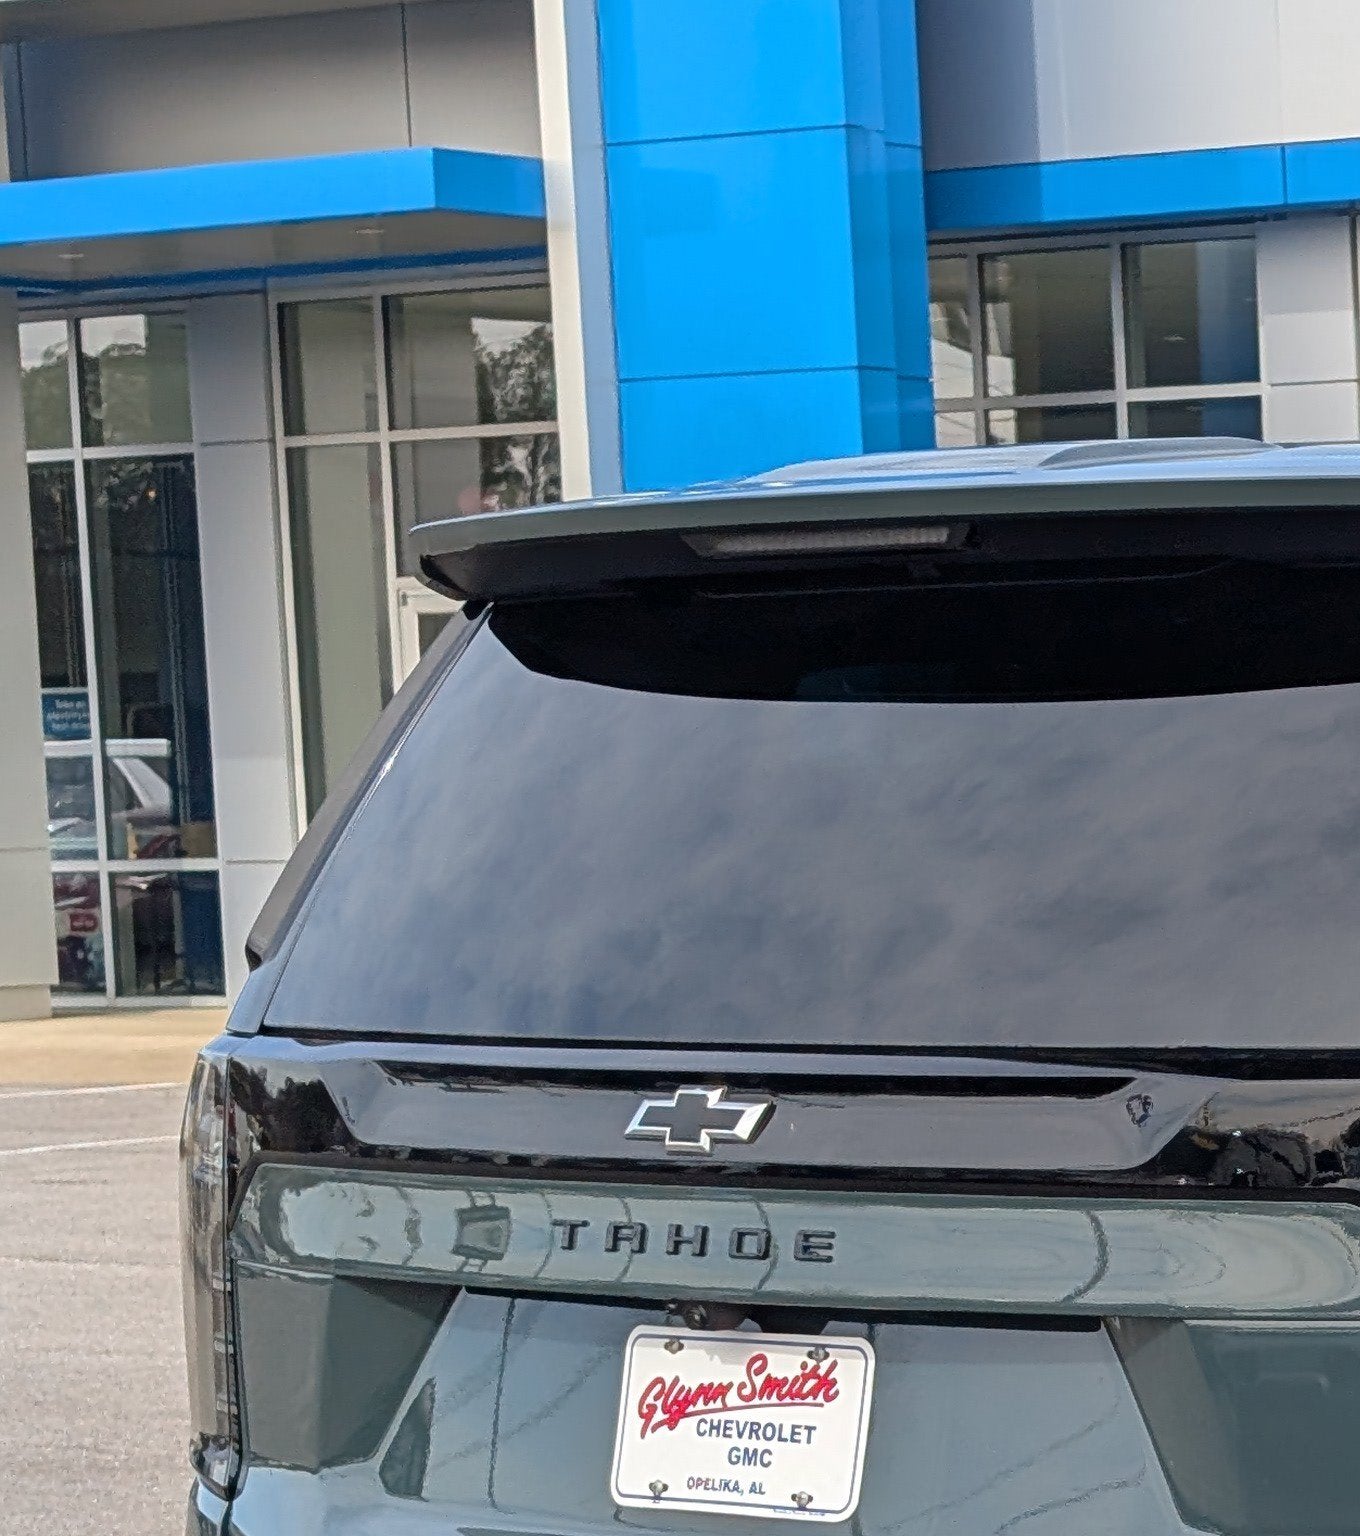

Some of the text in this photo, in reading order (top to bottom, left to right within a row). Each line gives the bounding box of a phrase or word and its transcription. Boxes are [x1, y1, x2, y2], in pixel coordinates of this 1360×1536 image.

[552, 1219, 836, 1263] TAHOE
[637, 1353, 839, 1439] Glynn Smith
[696, 1418, 817, 1445] CHEVROLET
[727, 1446, 773, 1468] GMC
